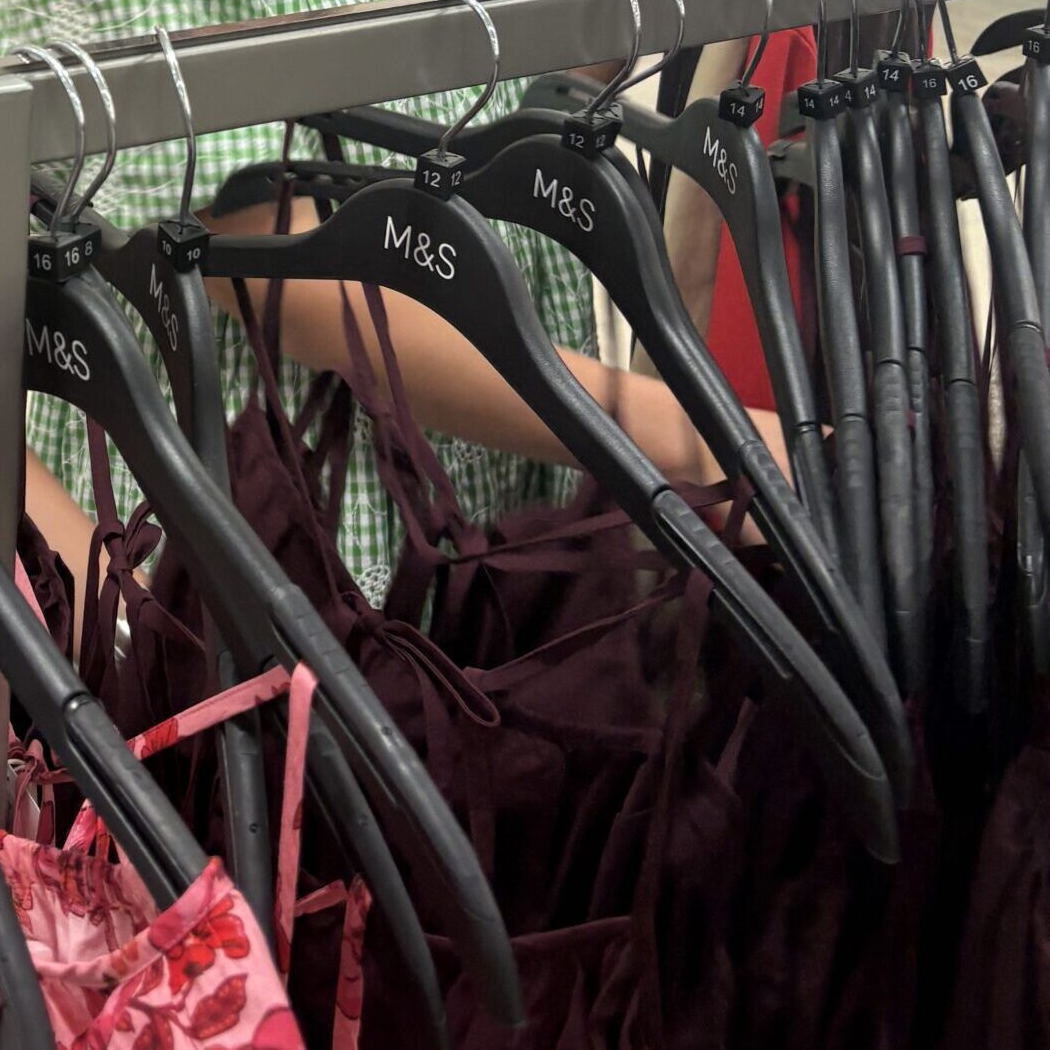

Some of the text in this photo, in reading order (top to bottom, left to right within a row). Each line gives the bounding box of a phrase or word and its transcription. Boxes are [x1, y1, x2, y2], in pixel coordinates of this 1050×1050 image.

[1027, 40, 1040, 53] 16
[882, 68, 900, 82] 14
[958, 74, 979, 91] 16
[864, 84, 876, 99] 14
[922, 78, 937, 89] 16
[804, 98, 815, 109] 14
[830, 95, 840, 107] 14
[730, 102, 746, 118] 14
[569, 133, 585, 149] 12
[703, 125, 738, 195] M&S
[422, 169, 442, 188] 12
[450, 170, 462, 187] 12
[533, 168, 597, 232] M&S
[162, 240, 172, 255] 10
[187, 247, 201, 262] 10
[384, 215, 458, 280] M&S
[33, 253, 52, 271] 16
[64, 247, 80, 267] 16
[150, 263, 179, 352] M&S
[25, 317, 91, 381] M&S
